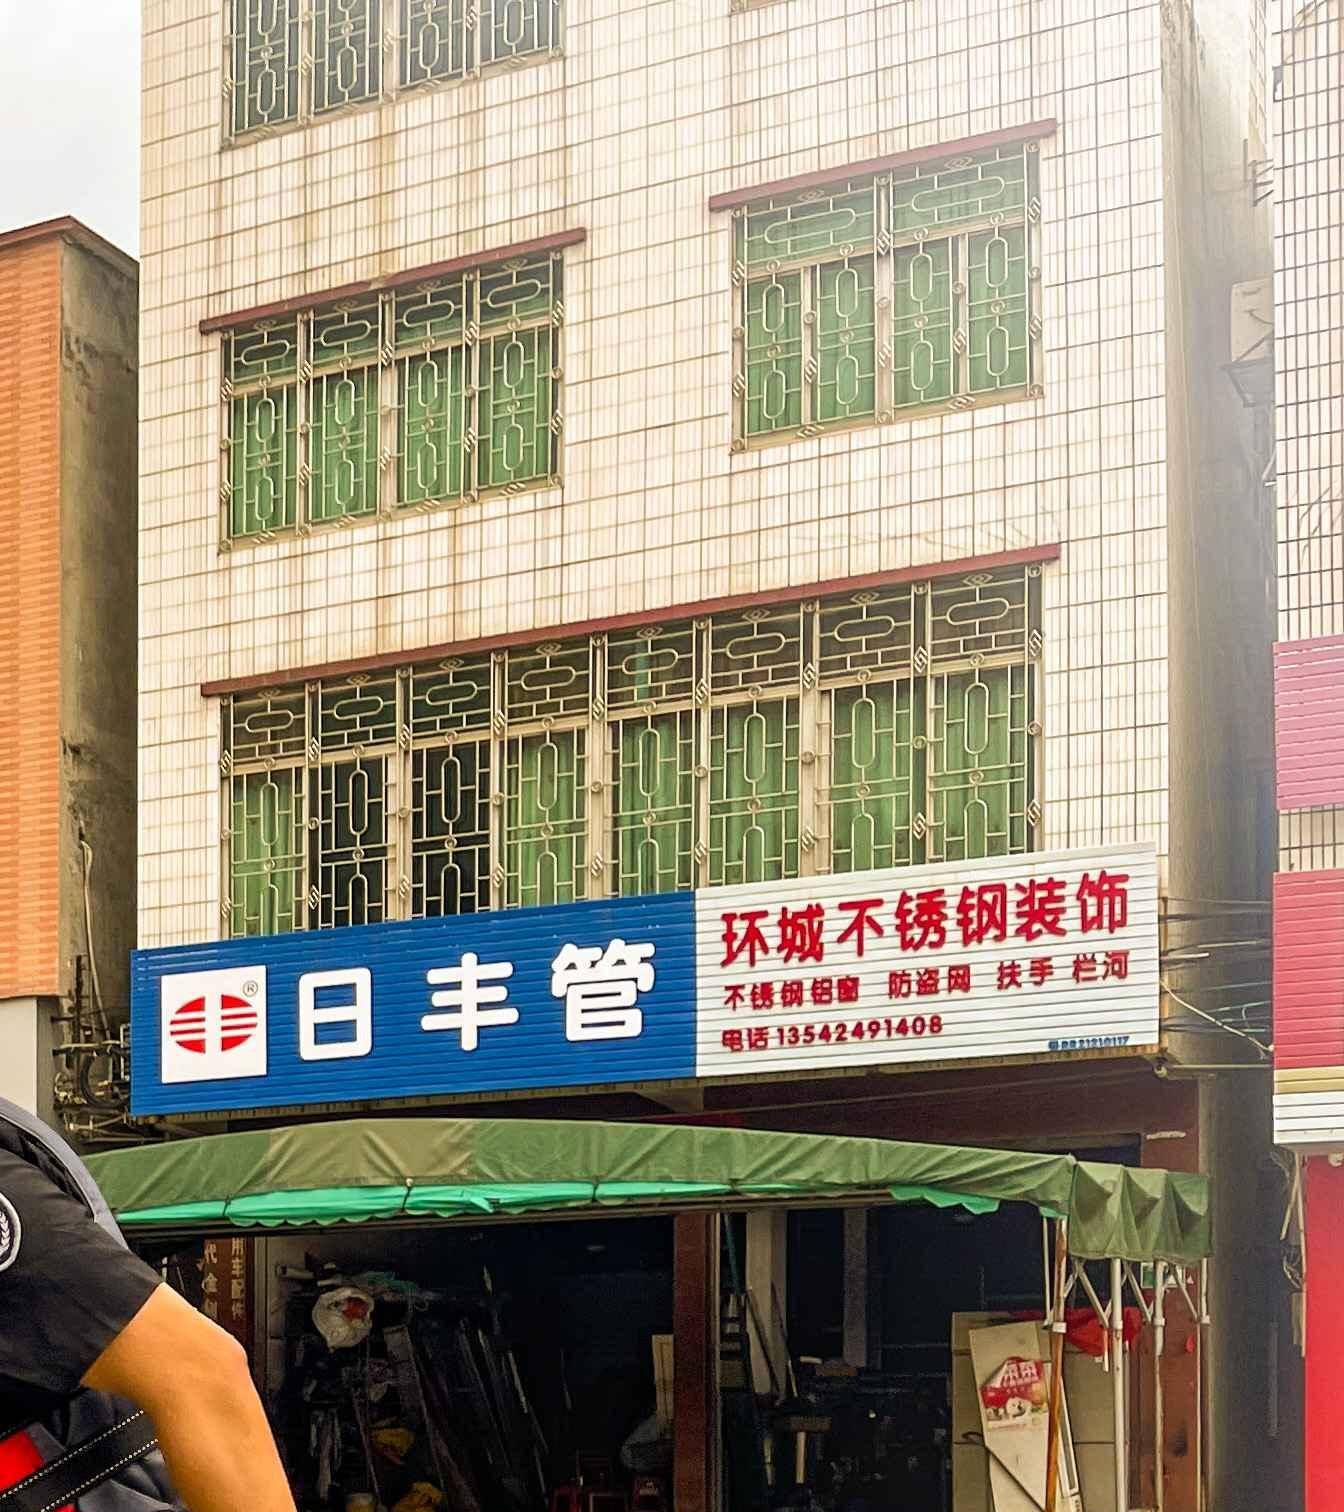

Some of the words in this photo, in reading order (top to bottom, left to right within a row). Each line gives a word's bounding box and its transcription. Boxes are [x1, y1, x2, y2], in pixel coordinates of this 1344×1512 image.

[720, 869, 1130, 968] 环城不锈钢装饰
[298, 938, 655, 1061] 日丰管
[888, 964, 972, 999] 防盗网
[996, 957, 1054, 990] 扶手
[1072, 950, 1131, 984] 栏河
[722, 1026, 769, 1053] 电话
[777, 1015, 944, 1046] 13542491408
